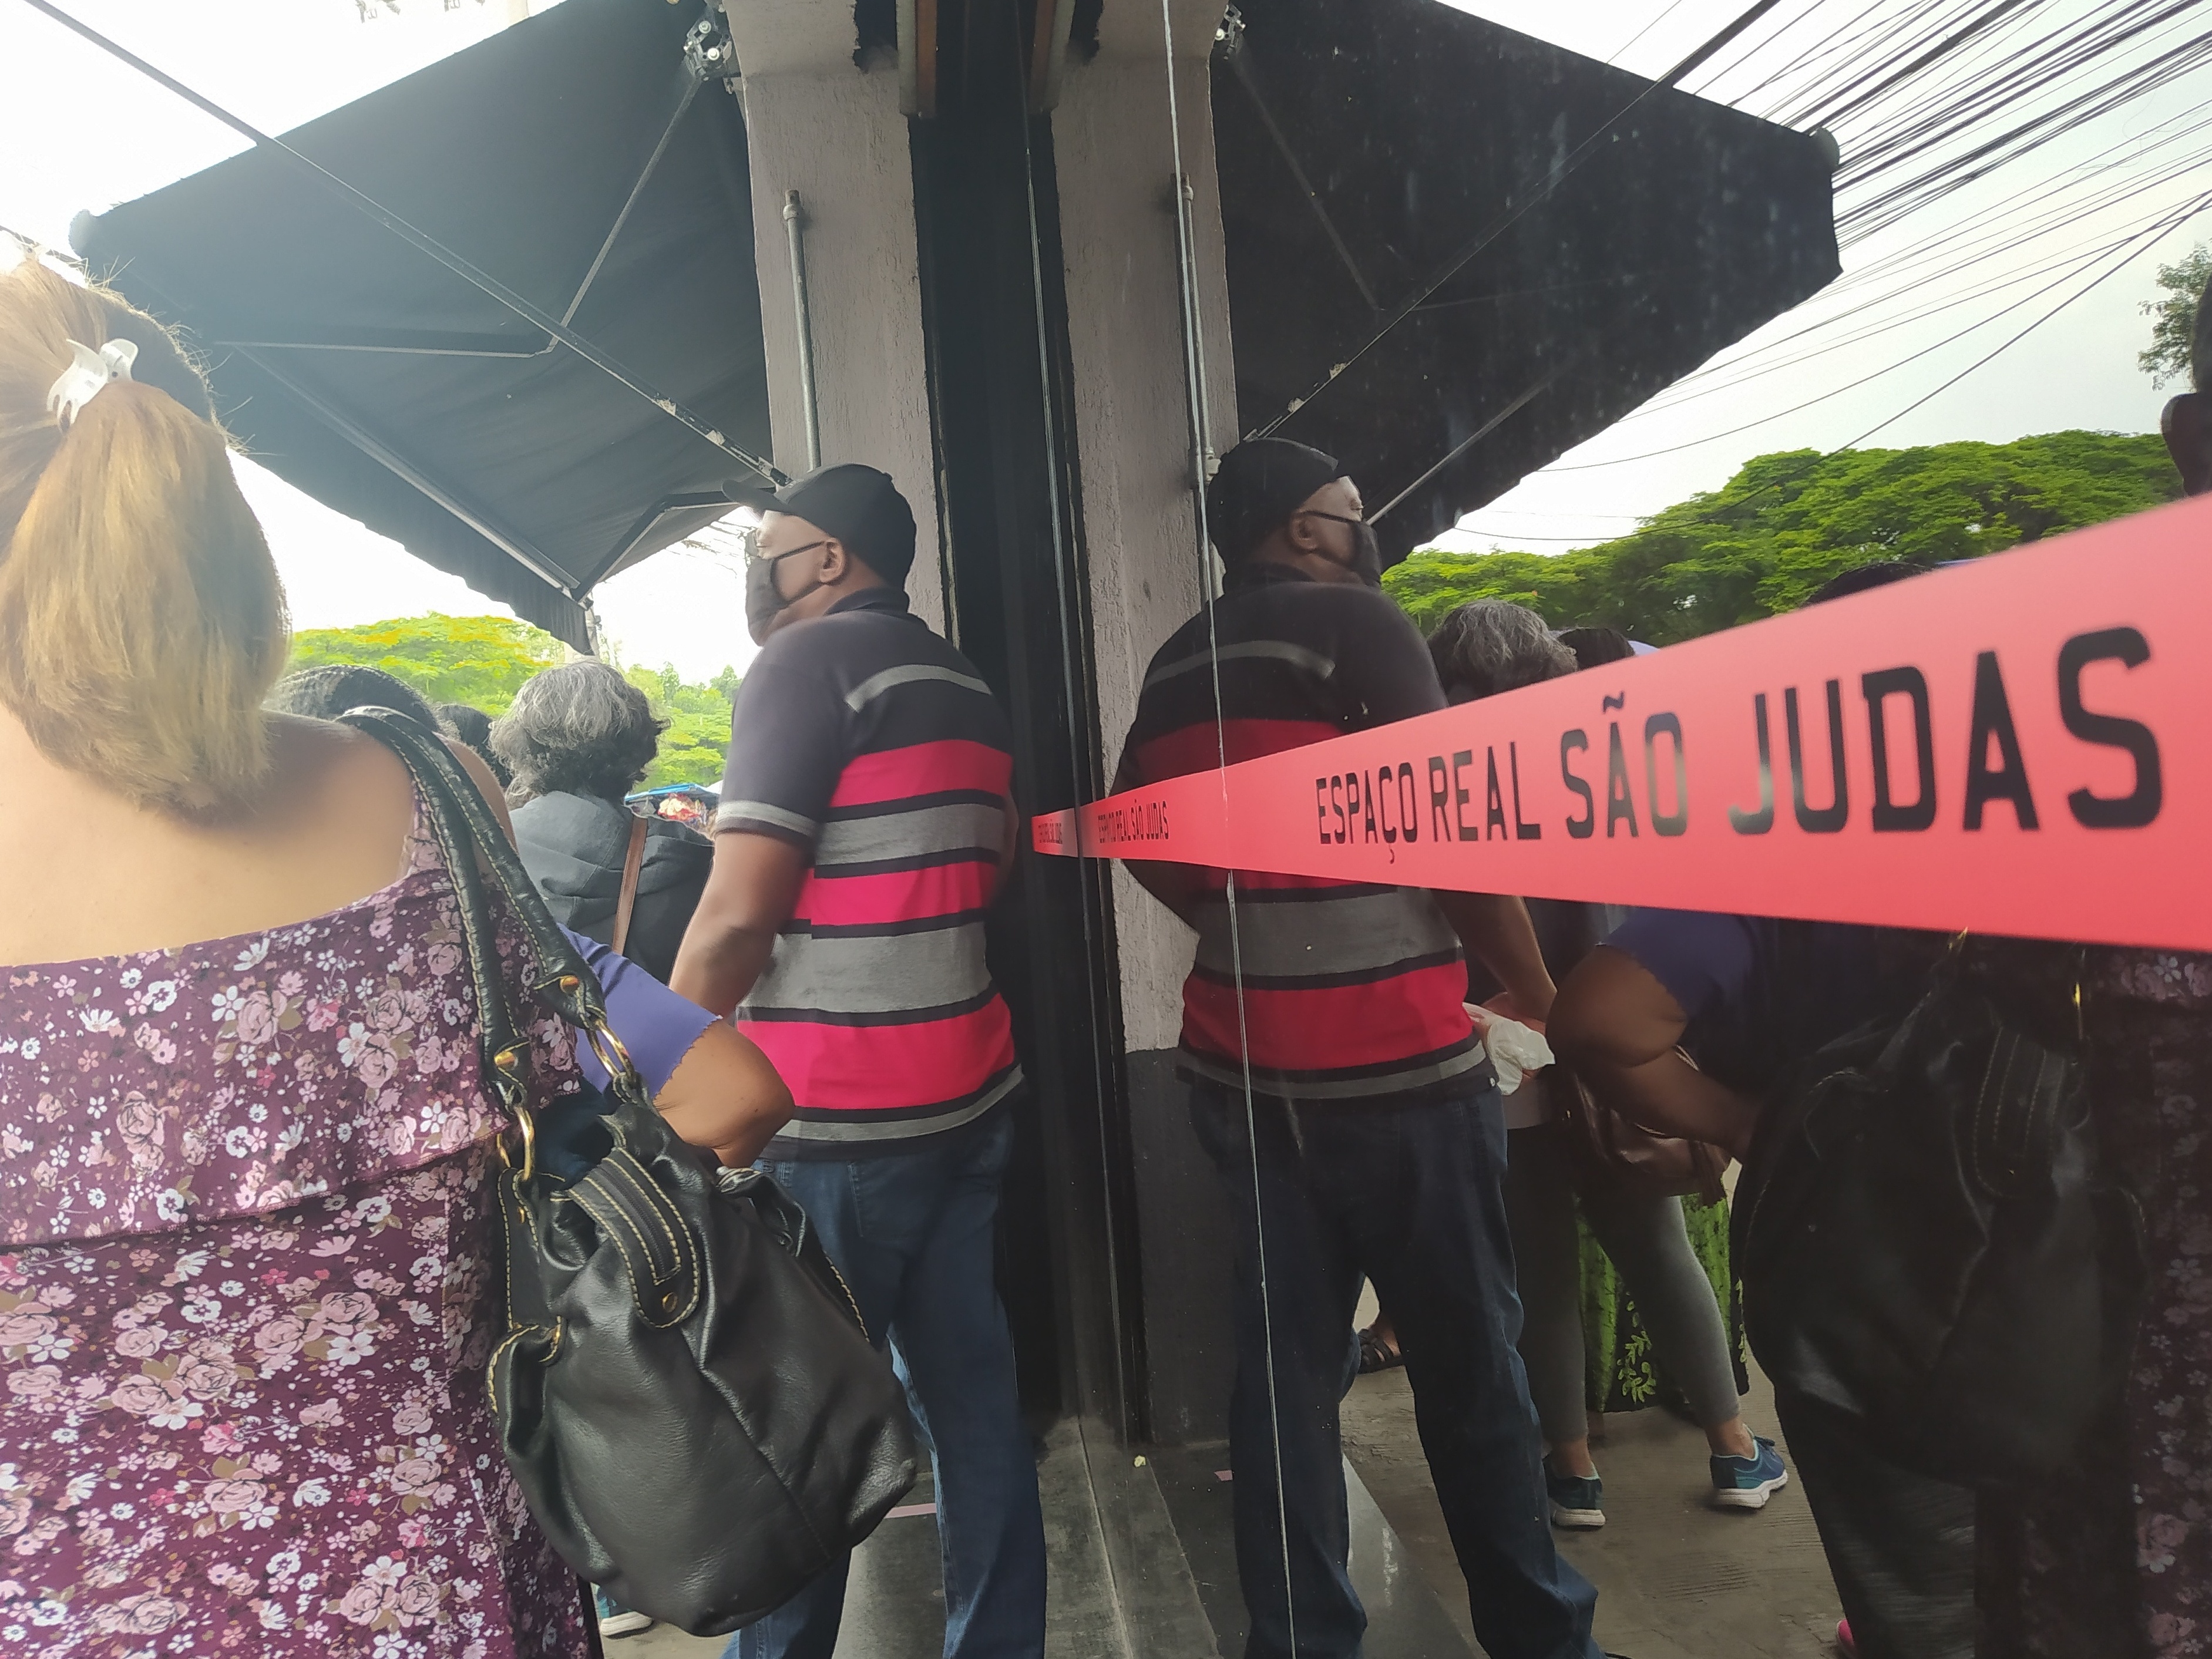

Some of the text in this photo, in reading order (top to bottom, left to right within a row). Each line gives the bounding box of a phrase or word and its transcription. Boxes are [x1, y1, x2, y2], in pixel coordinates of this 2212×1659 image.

[1315, 625, 2164, 864] ESPAÇO REAL SÃO JUDAS
[1146, 800, 1169, 840] JUDAS
